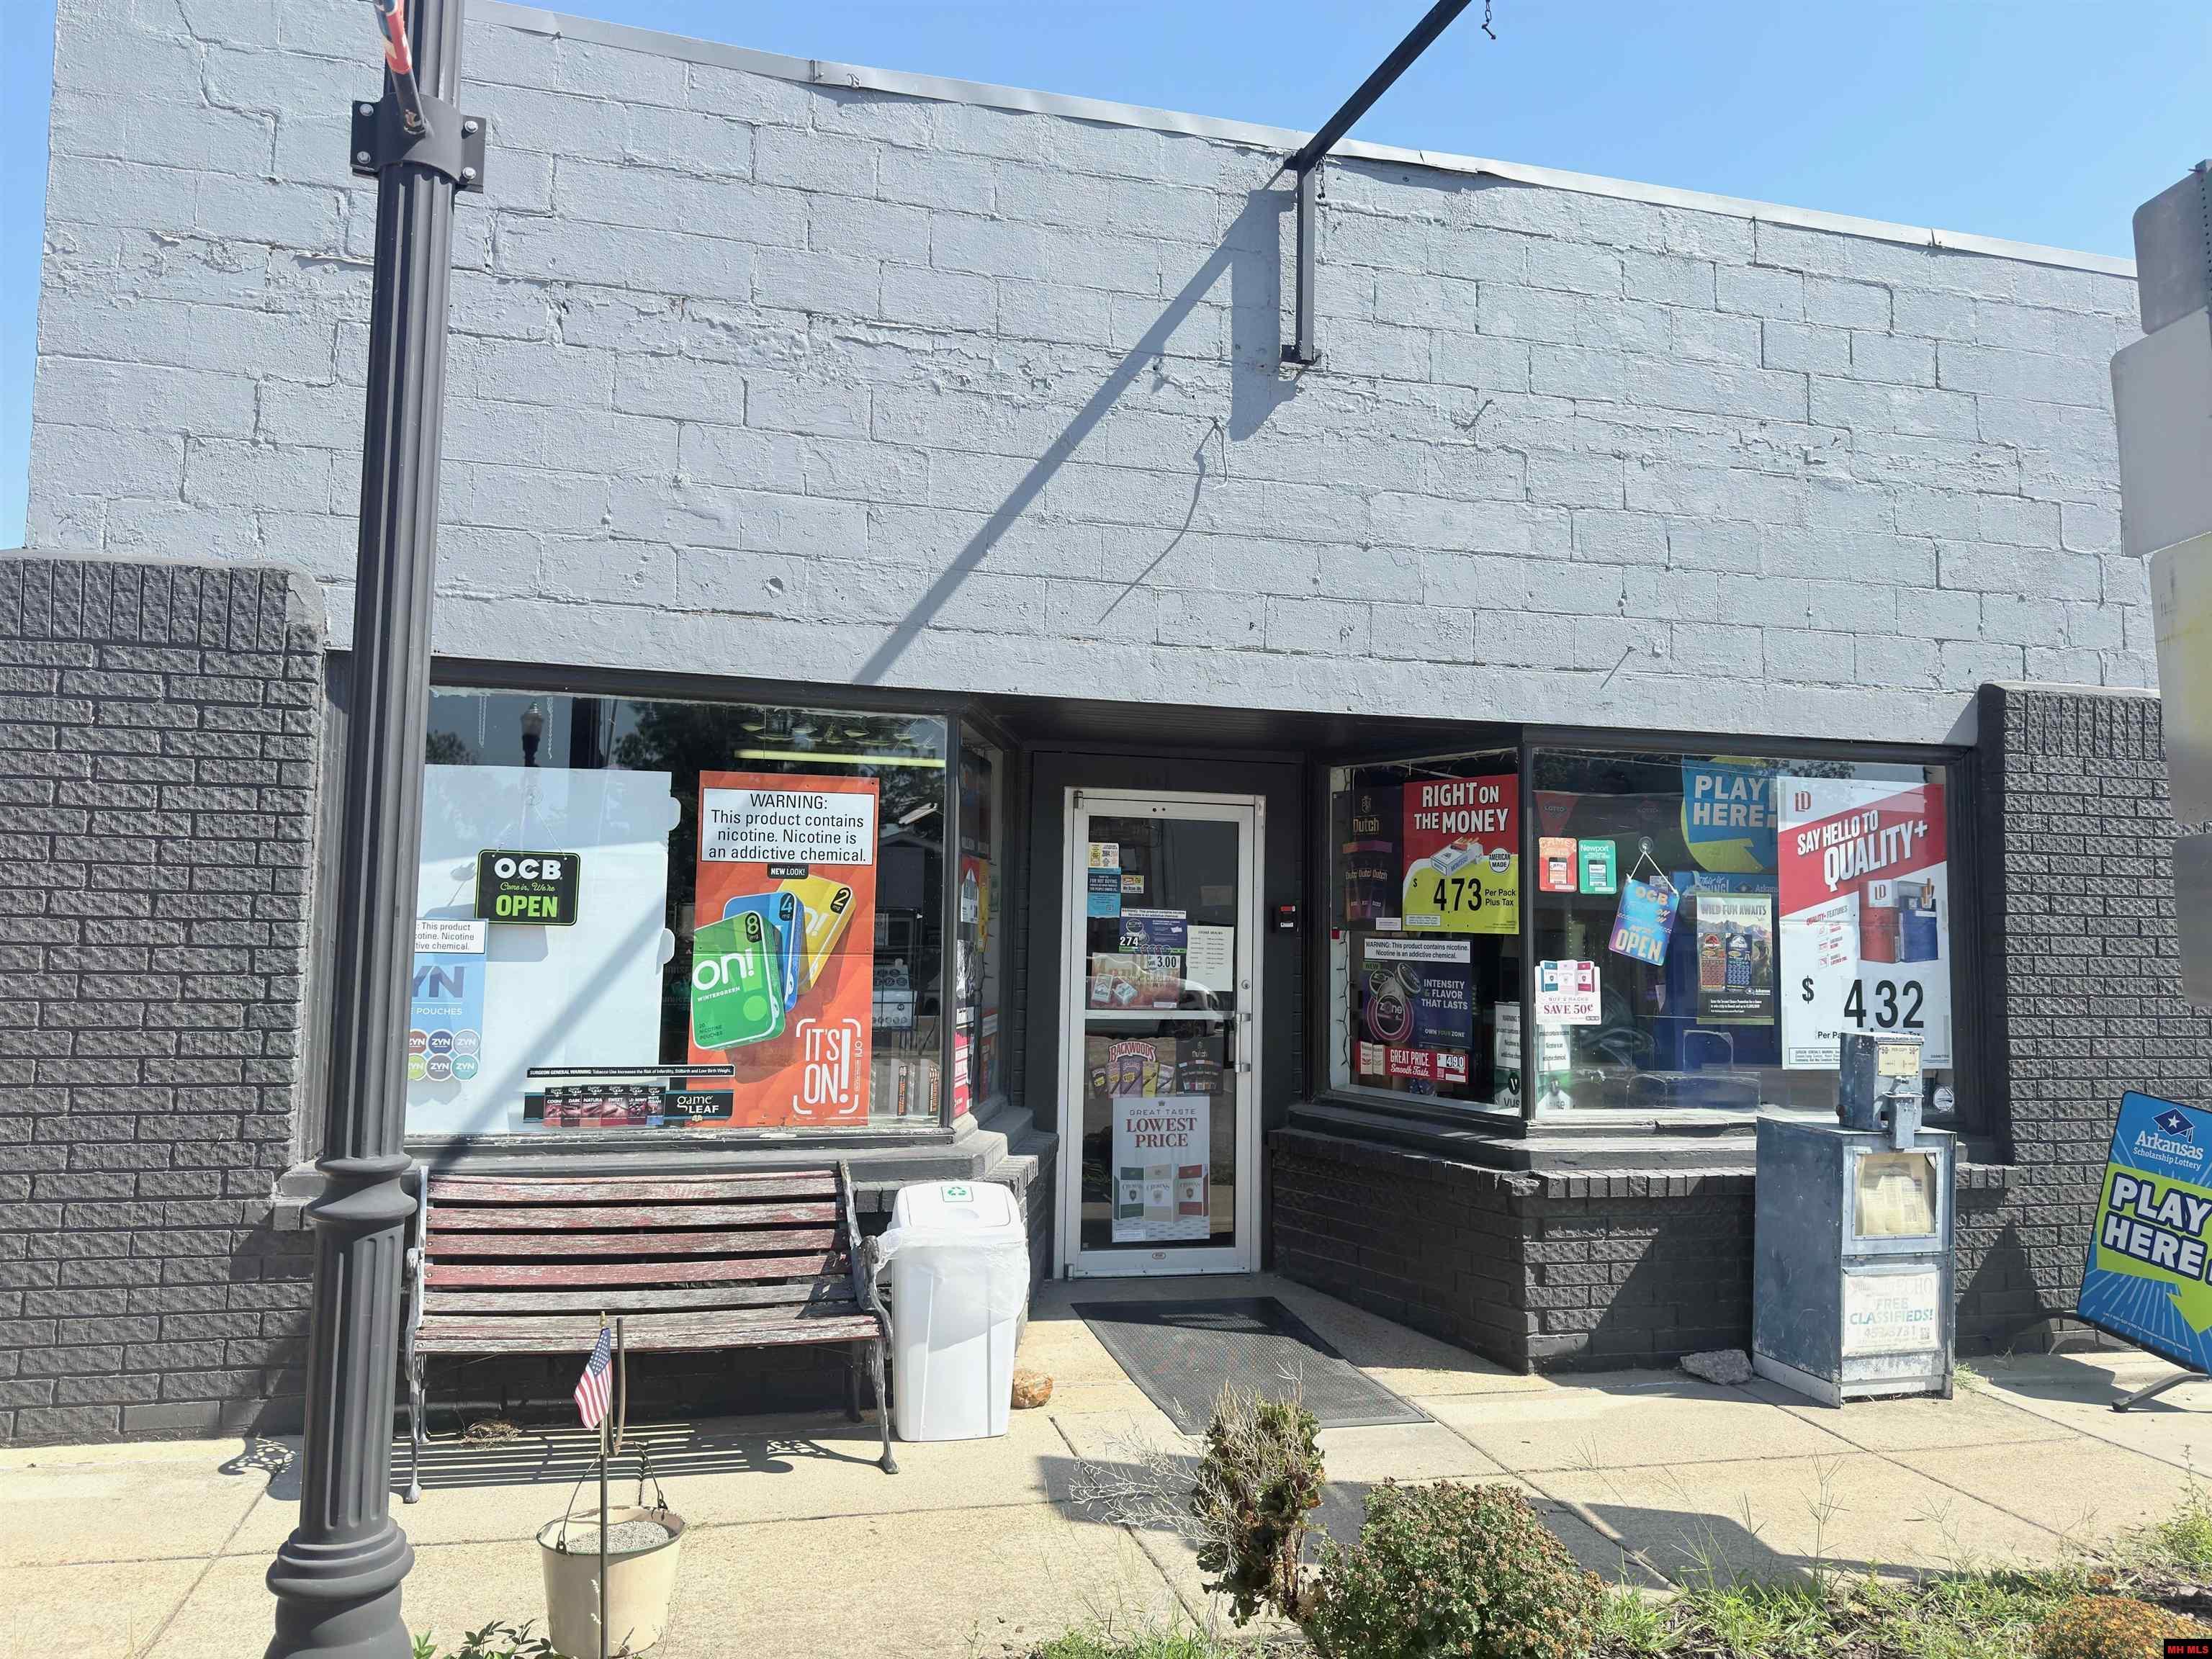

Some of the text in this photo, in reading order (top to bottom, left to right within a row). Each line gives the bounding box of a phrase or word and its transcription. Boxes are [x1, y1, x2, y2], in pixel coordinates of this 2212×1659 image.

[1423, 783, 1498, 807] RIGHT ON
[1694, 775, 1763, 799] PLAY
[750, 793, 828, 809] WARNING:
[711, 810, 864, 827] This product contains
[1353, 818, 1379, 832] Dutch
[1414, 809, 1509, 834] THE MONEY
[718, 830, 856, 845] nicotine. Nicotine is
[1797, 810, 1878, 855] SAY HELLO TO
[709, 845, 866, 862] an addictive chemical.
[494, 858, 562, 880] OCB
[500, 882, 519, 891] Come
[496, 894, 558, 917] OPEN
[781, 895, 793, 912] 4
[833, 889, 849, 906] 2
[1701, 904, 1766, 915] WILD FUN AWAITS
[747, 914, 759, 935] 8
[1120, 937, 1138, 946] 274
[1615, 929, 1663, 961] OPEN
[693, 948, 755, 990] on!
[1157, 956, 1177, 967] 3.00
[1424, 979, 1465, 989] INTENSITY
[1802, 975, 1814, 1004] $
[697, 986, 740, 1002] WINTERGREEN
[1431, 989, 1463, 999] FLAVOR
[1380, 1002, 1403, 1015] zone
[1421, 999, 1468, 1010] THAT LASTS
[1544, 1004, 1594, 1015] SAVE 50¢
[699, 1030, 722, 1040] POUCHES
[806, 1028, 841, 1061] IT'S
[854, 1040, 864, 1058] on!
[1108, 1040, 1156, 1061] BACKWOODS
[1390, 1049, 1409, 1064] GREAT
[1447, 1056, 1464, 1067] 490
[1390, 1064, 1411, 1075] Smooth
[678, 1095, 713, 1112] game
[1126, 1118, 1197, 1133] LOWEST
[1135, 1133, 1189, 1148] PRICE
[2134, 1130, 2204, 1161] Arkansas
[2132, 1146, 2202, 1171] Scholarship Lottery
[2110, 1174, 2212, 1234] PLAY
[2104, 1215, 2212, 1281] HERE
[1876, 1298, 1908, 1310] FREE
[1850, 1309, 1933, 1325] CLASSIFIEDS!
